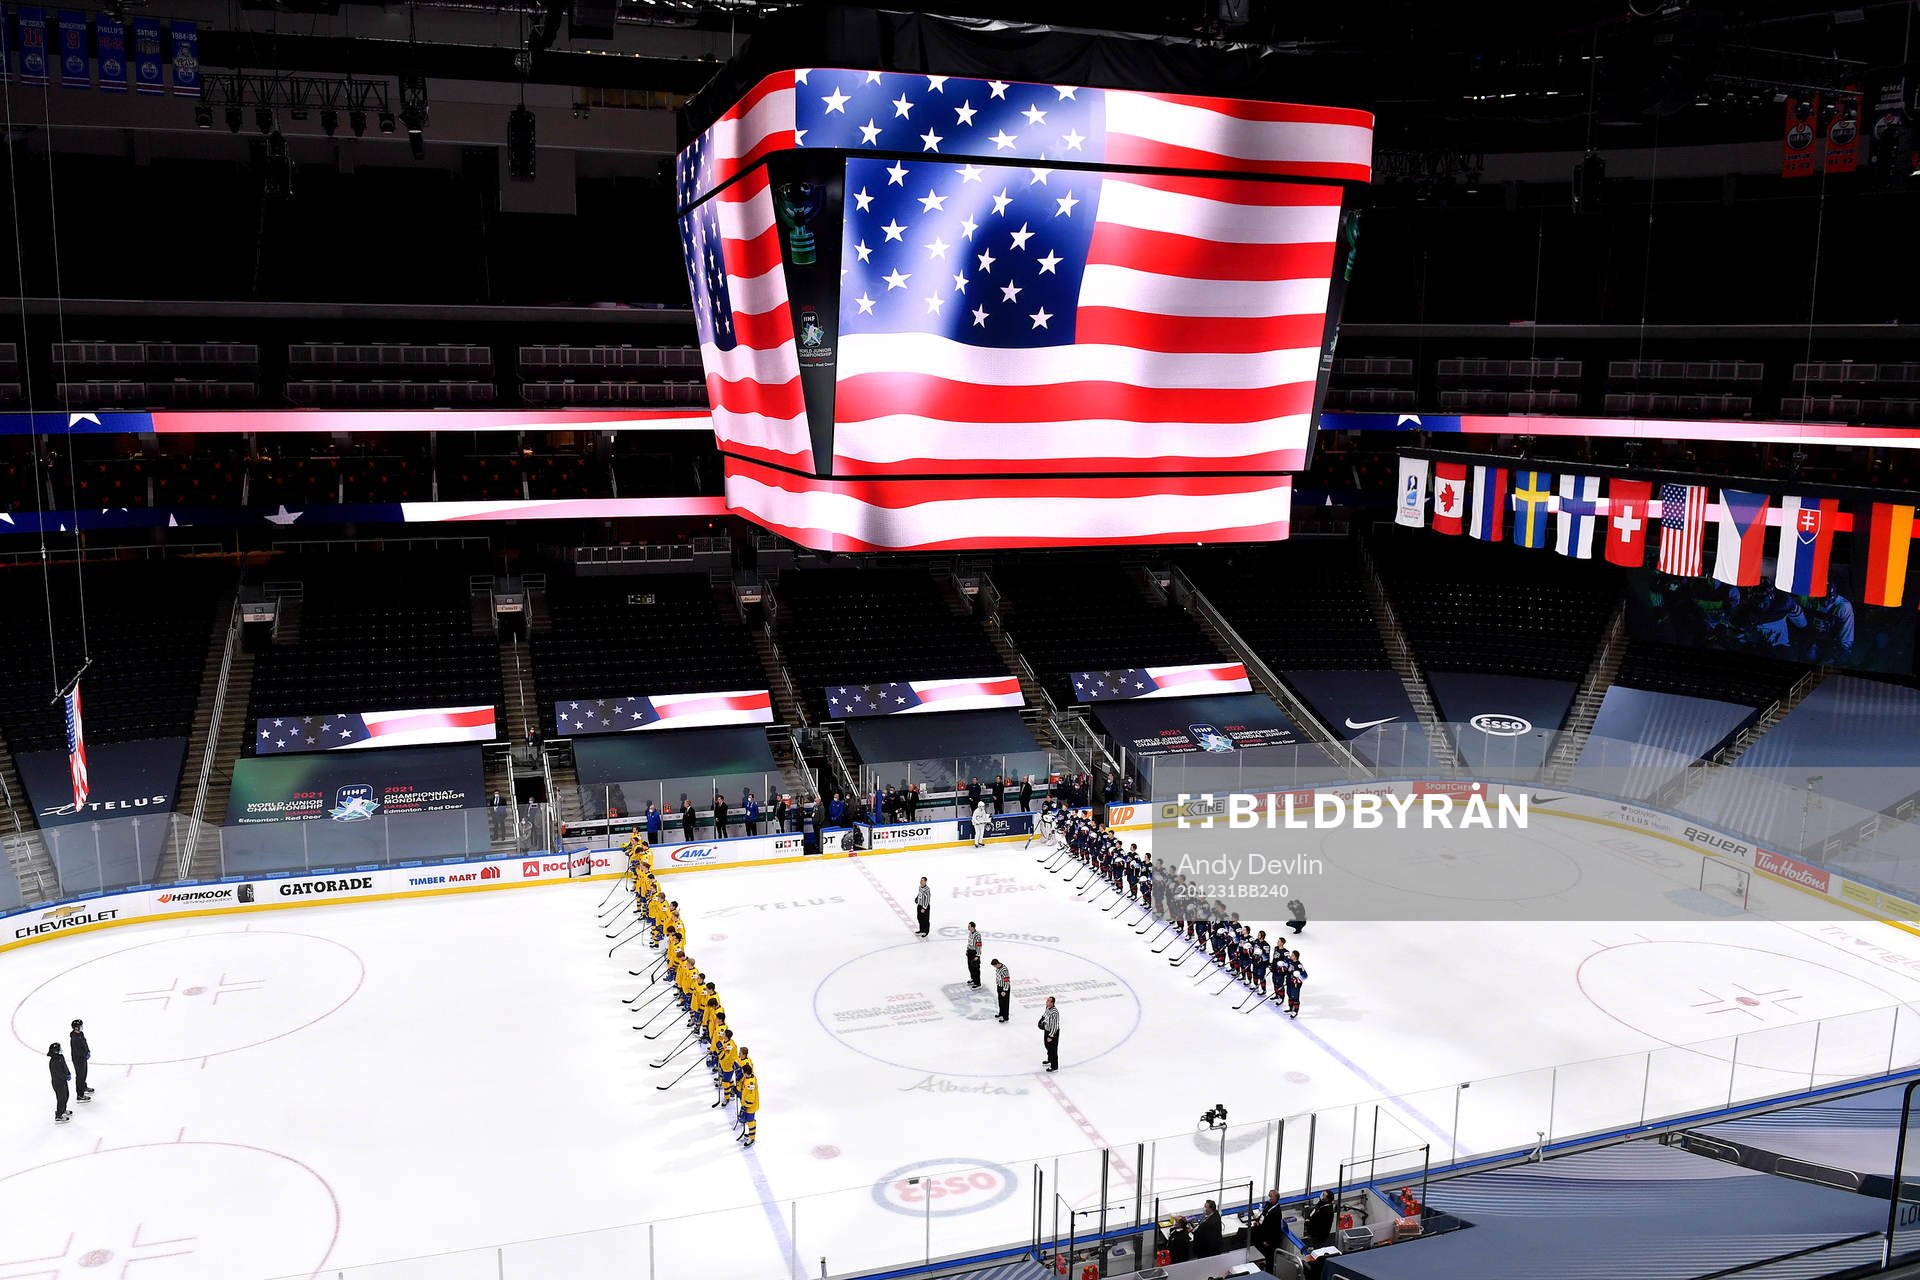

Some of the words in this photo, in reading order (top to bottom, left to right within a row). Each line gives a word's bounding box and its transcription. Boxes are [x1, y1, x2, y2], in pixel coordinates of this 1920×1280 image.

[342, 788, 367, 796] IIHF
[384, 785, 414, 793] 2021
[384, 790, 454, 800] CHAMPIONNAT
[384, 797, 428, 805] MONDIAL
[429, 793, 465, 801] JUNIOR
[88, 795, 169, 811] TELUS
[247, 800, 285, 808] WORLD
[247, 804, 323, 812] CHAMPIONSHIP
[384, 807, 422, 815] Edmonton
[1162, 804, 1192, 819] OK
[238, 816, 279, 824] Edmonton
[995, 820, 1010, 828] BFL
[1620, 813, 1649, 826] TELUS
[890, 827, 931, 838] TISSOT
[680, 848, 712, 859] AMJ
[1757, 851, 1779, 873] Tim
[1779, 859, 1826, 890] Hortons
[409, 876, 446, 886] TIMBER
[449, 873, 478, 882] MART
[279, 877, 373, 896] GATORADE
[752, 895, 846, 911] TELUS
[15, 909, 119, 939] CHEVROLET
[886, 992, 923, 1003] 2021
